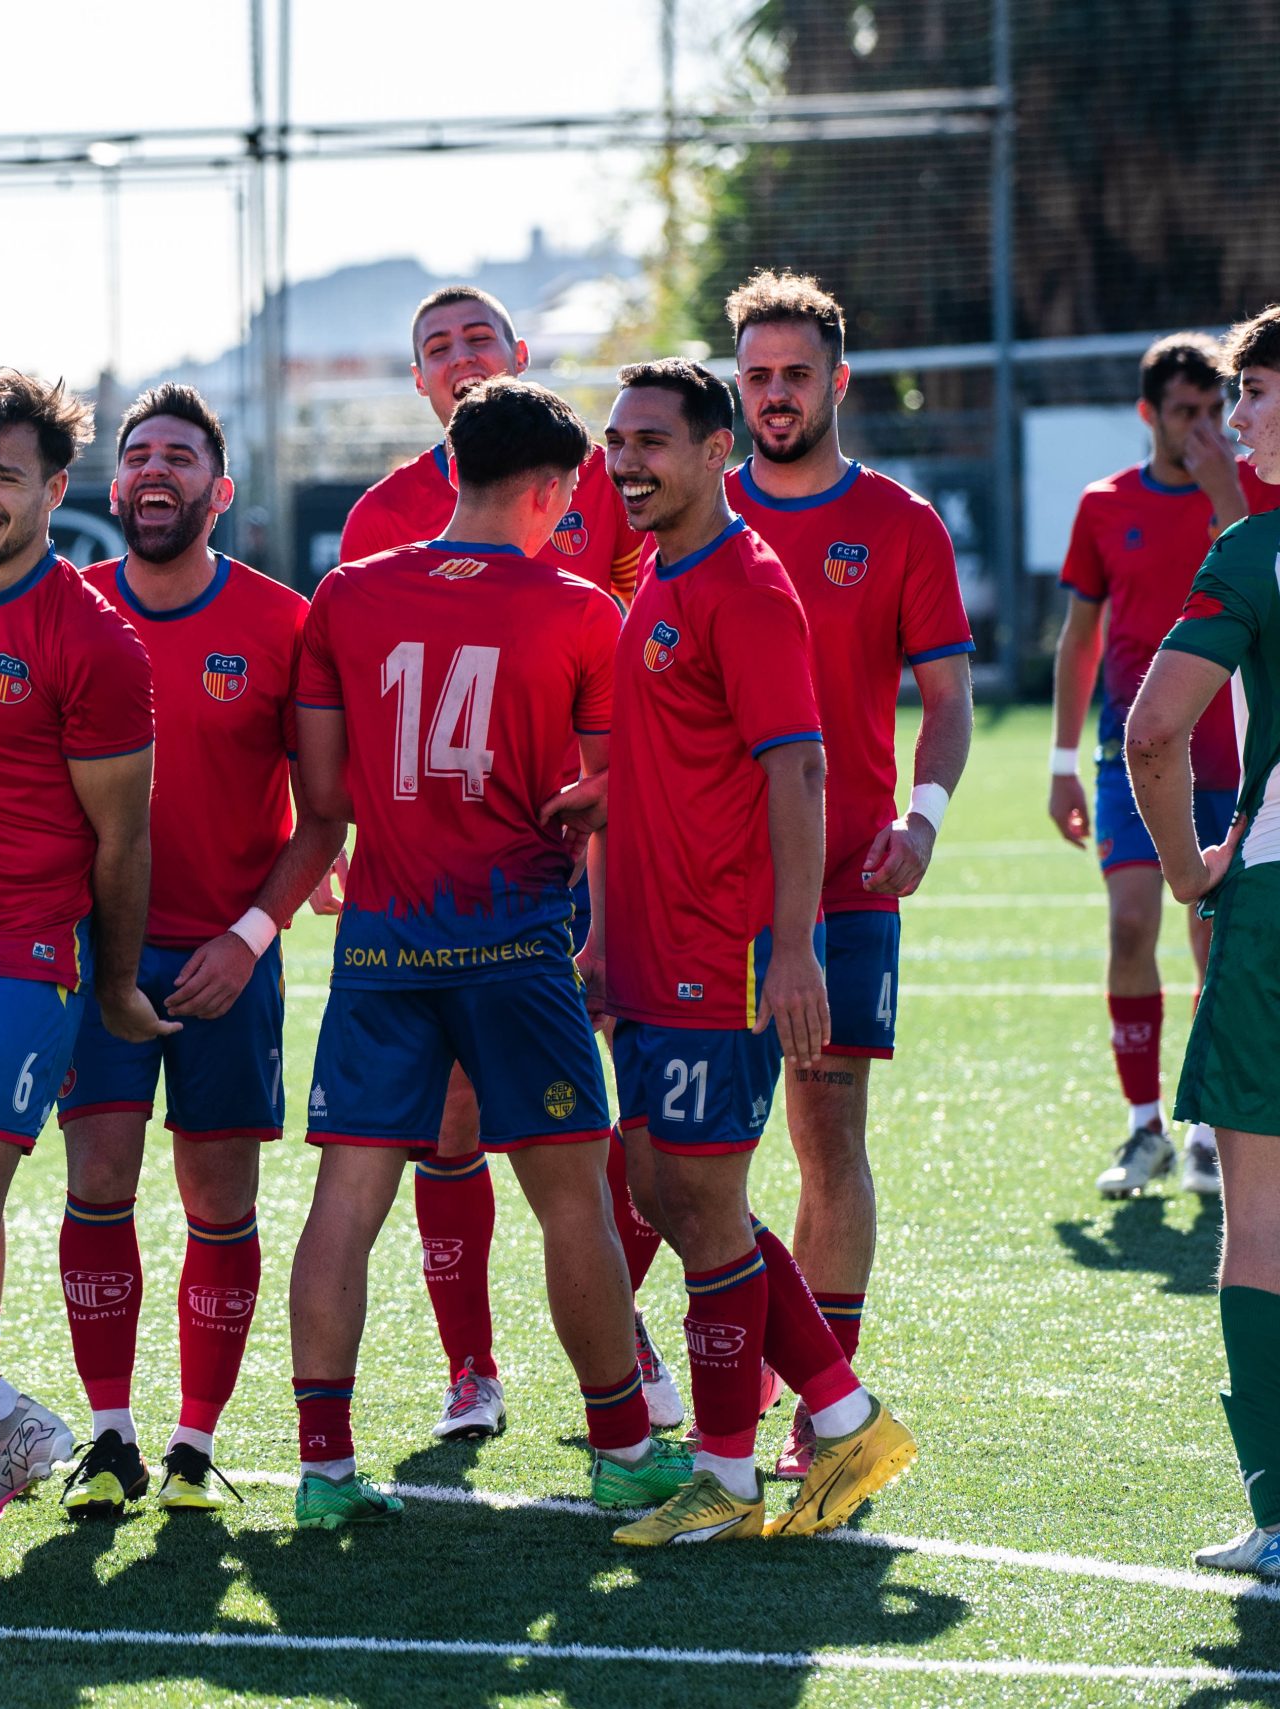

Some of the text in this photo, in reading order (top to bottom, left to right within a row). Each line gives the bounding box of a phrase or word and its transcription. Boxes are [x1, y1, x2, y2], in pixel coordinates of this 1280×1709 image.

[837, 546, 859, 556] FCM
[657, 627, 672, 640] FCM
[215, 659, 237, 668] FCM
[381, 641, 500, 802] 14
[344, 940, 545, 968] SOM MARTINENC
[876, 972, 892, 1031] 4
[13, 1052, 38, 1114] 6
[663, 1059, 708, 1122] 21
[77, 1273, 116, 1282] FCM
[201, 1289, 240, 1297] FCM
